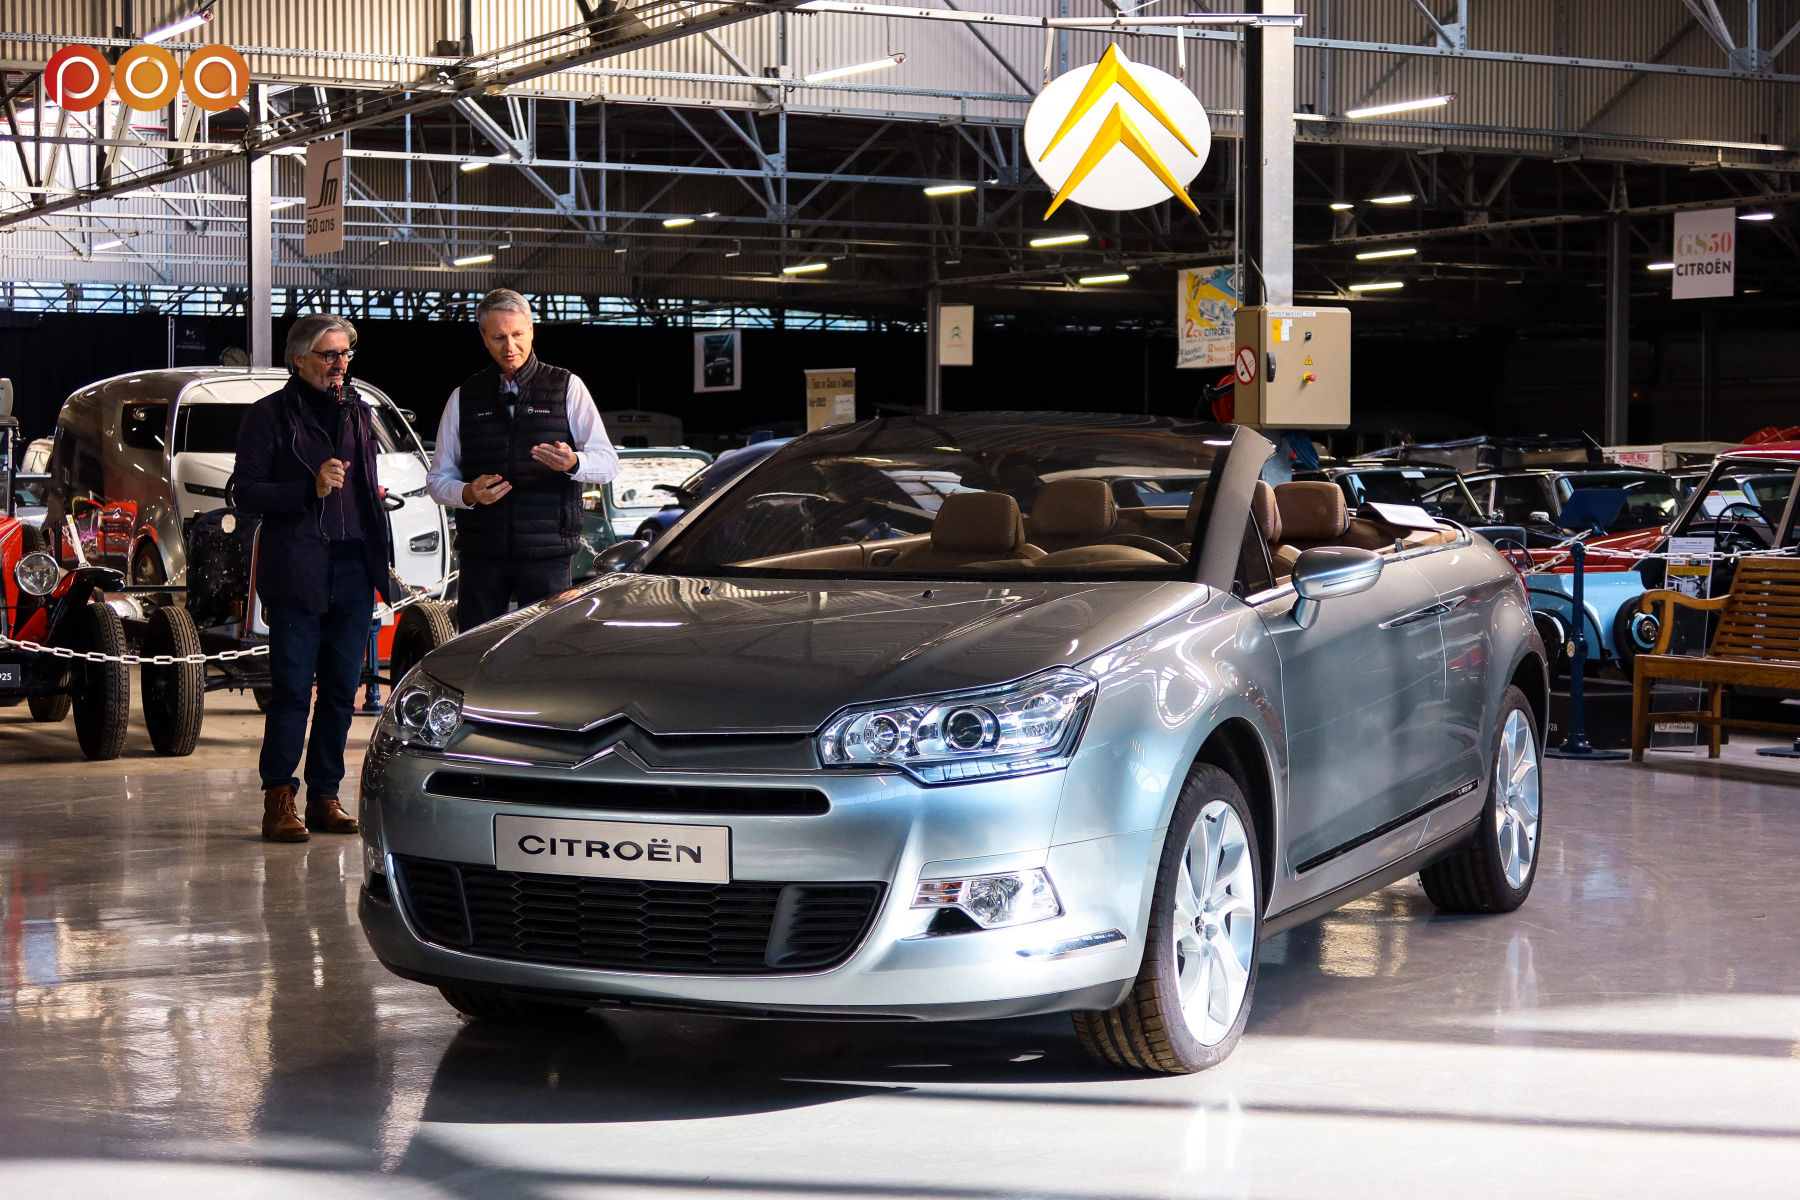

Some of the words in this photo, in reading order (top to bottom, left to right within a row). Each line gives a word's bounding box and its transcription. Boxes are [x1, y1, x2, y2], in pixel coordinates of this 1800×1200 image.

[307, 218, 318, 235] 50
[320, 218, 335, 233] ans
[1676, 258, 1732, 277] CITROËN
[517, 834, 702, 864] CITROËN
